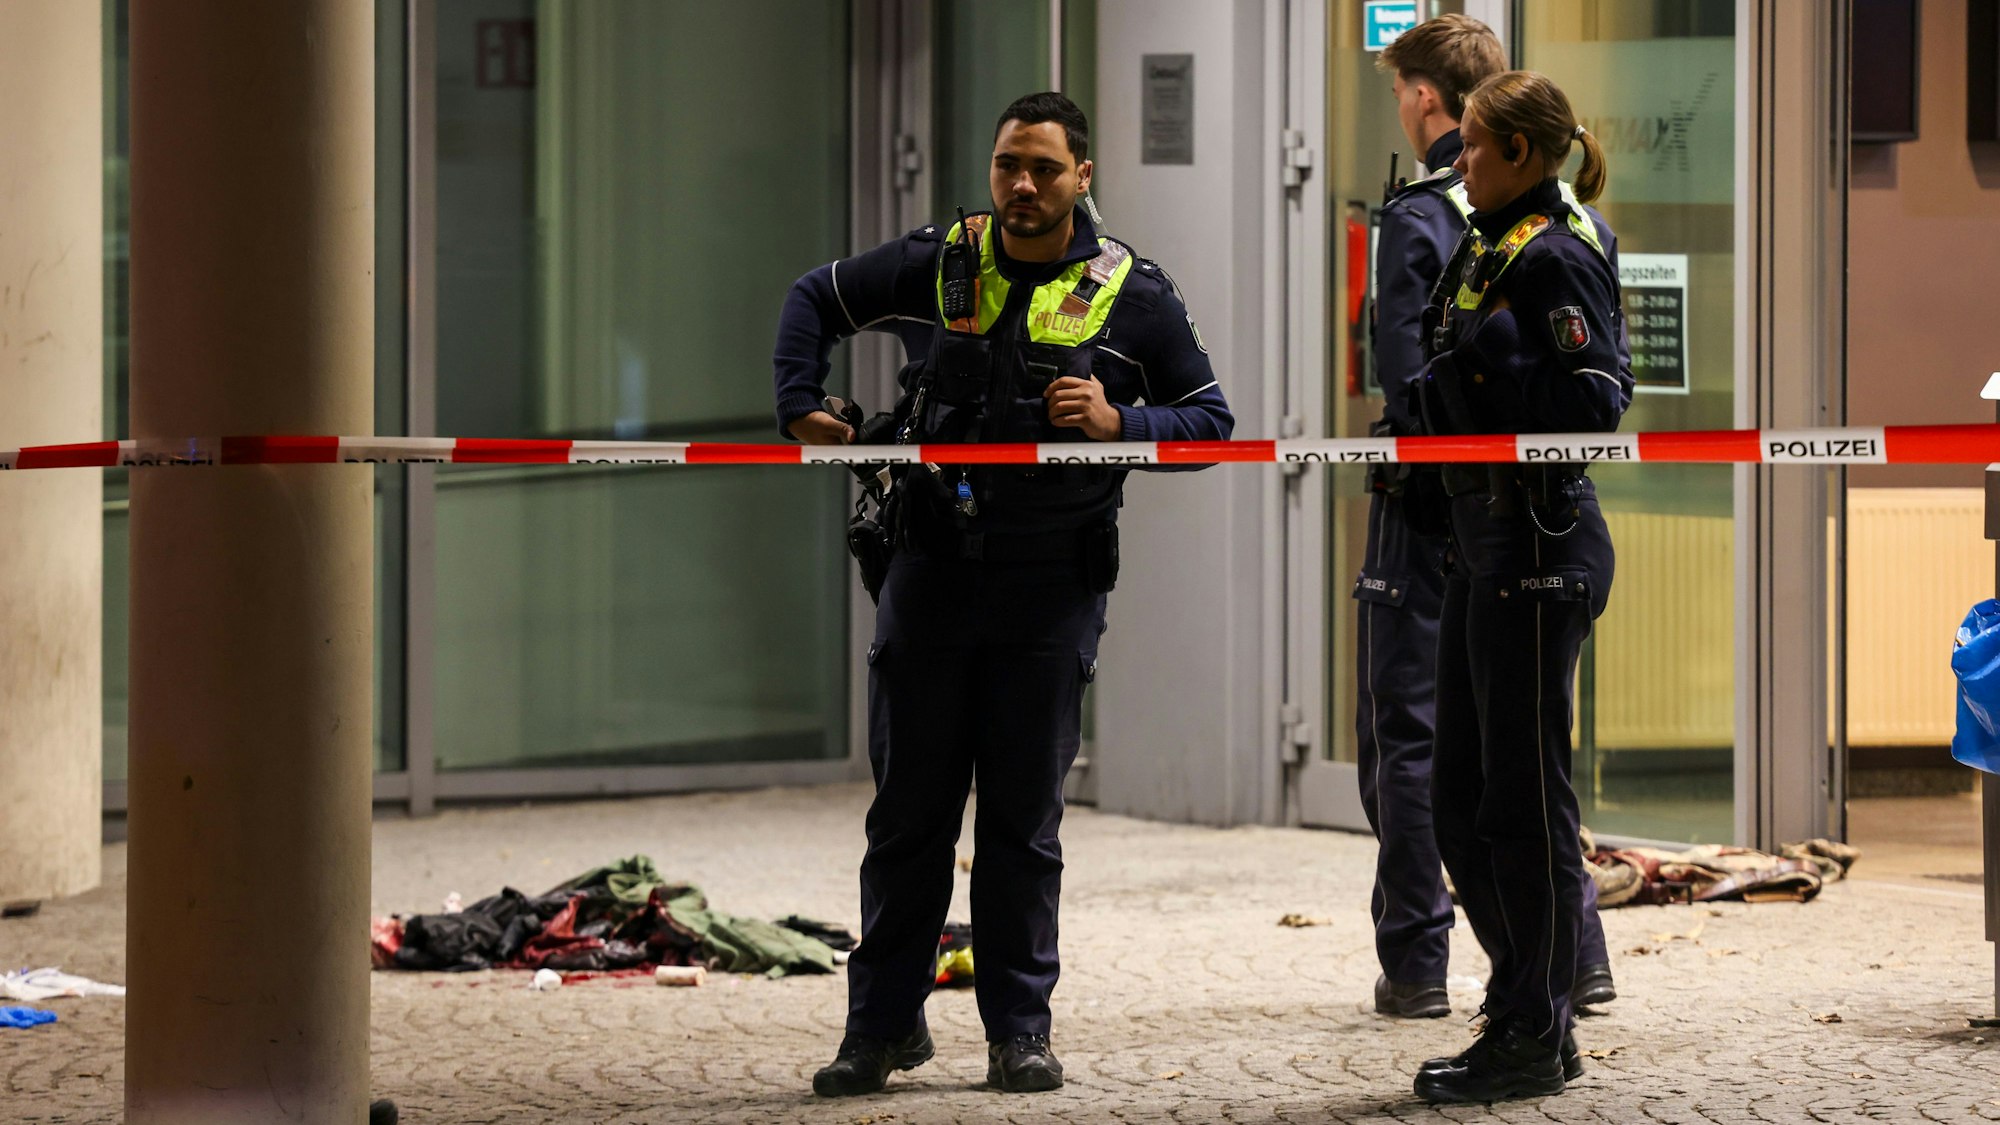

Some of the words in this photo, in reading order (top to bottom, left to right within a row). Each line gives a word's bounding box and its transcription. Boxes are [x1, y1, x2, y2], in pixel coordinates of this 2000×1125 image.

[1620, 264, 1677, 282] ungszeiten
[1033, 310, 1087, 337] POLIZEI
[1526, 446, 1630, 461] POLIZEI
[1769, 440, 1876, 458] POLIZEI
[1520, 576, 1564, 590] POLIZEI
